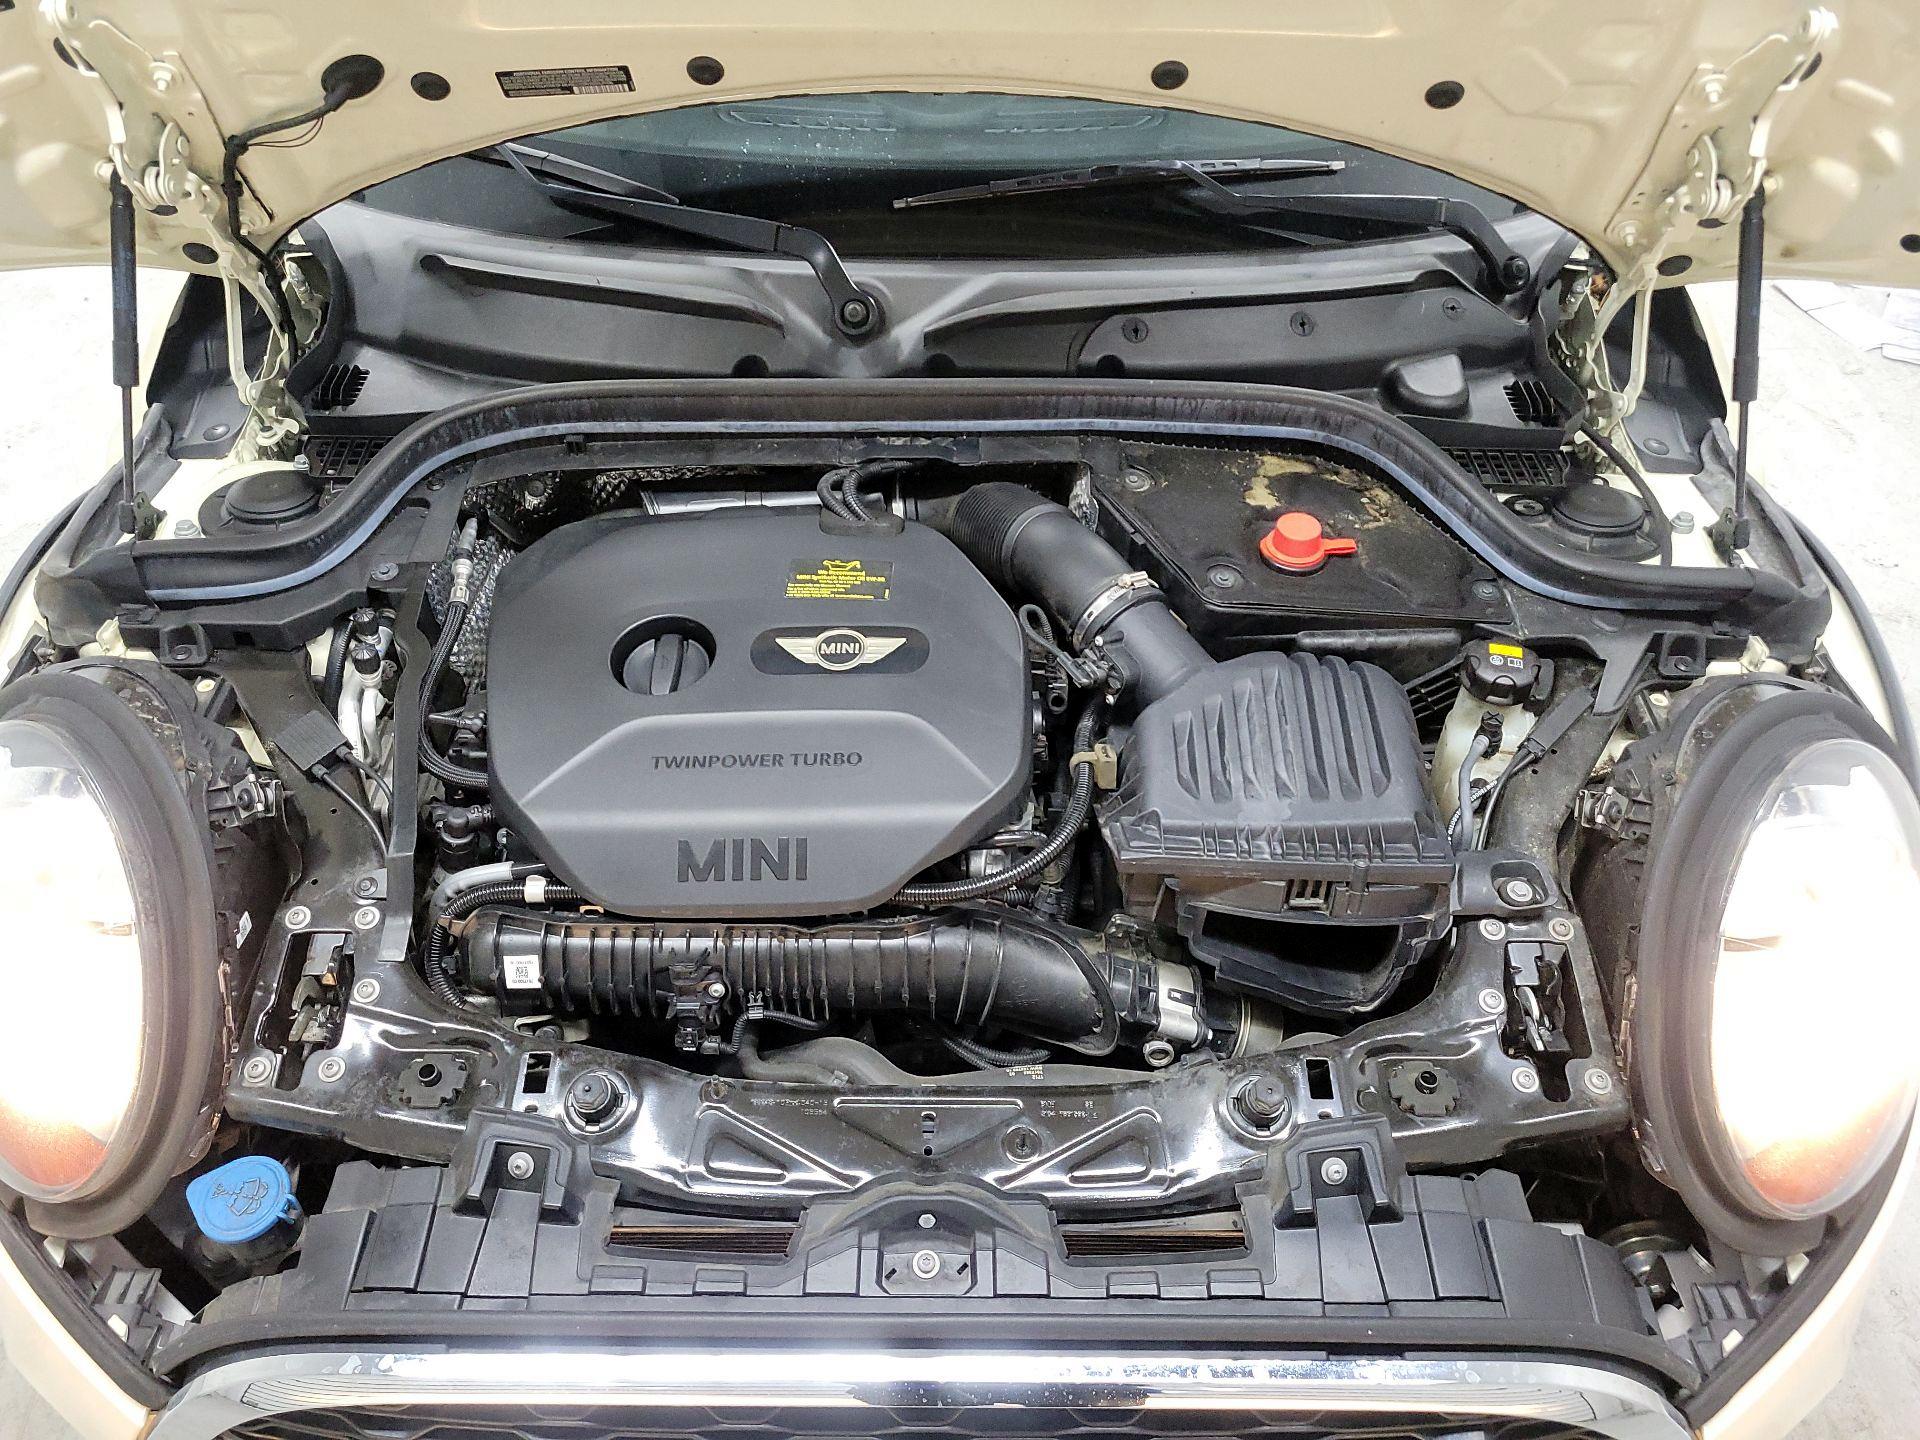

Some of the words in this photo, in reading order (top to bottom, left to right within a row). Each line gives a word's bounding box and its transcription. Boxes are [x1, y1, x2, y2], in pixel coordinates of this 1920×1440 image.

[820, 642, 860, 655] MINI
[651, 753, 784, 770] TWINPOWER
[790, 751, 863, 768] TURBO
[677, 836, 808, 883] MINI
